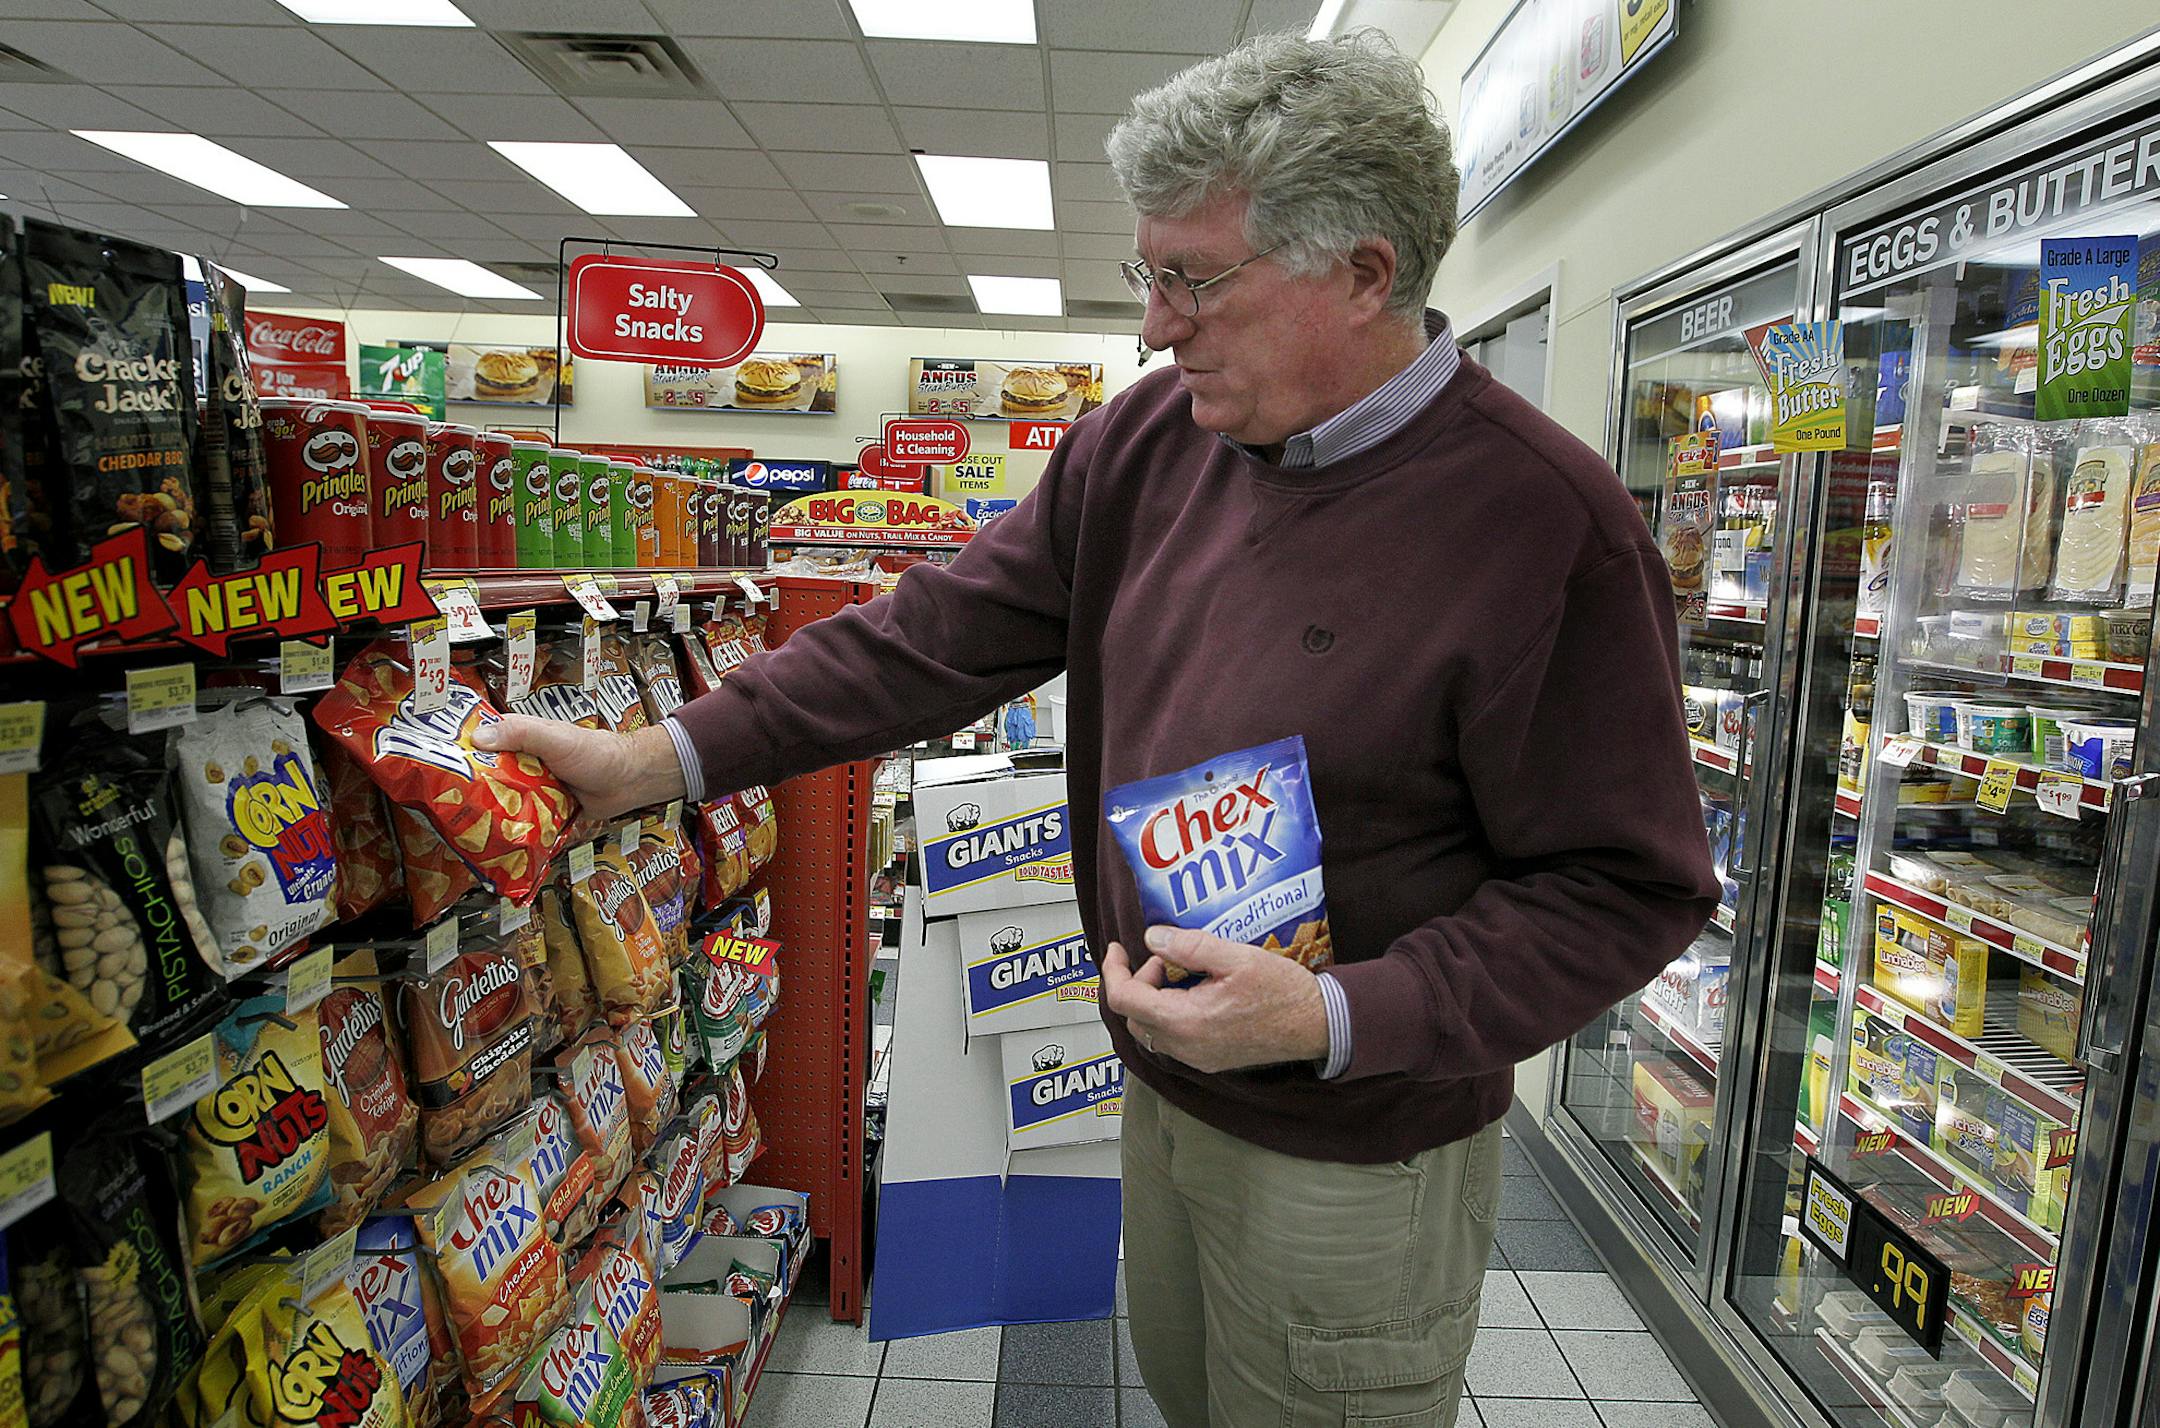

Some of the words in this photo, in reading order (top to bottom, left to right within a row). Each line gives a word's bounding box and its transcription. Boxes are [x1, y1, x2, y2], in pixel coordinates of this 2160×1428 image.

[1849, 217, 1941, 286] EGGS
[1948, 204, 1975, 250] &
[2047, 249, 2082, 267] Grade
[2084, 248, 2093, 265] A
[2096, 247, 2130, 267] Large
[48, 282, 96, 308] NEW!
[628, 283, 694, 316] Salty
[2046, 275, 2130, 339] Fresh
[614, 313, 705, 344] Snacks
[1680, 295, 1735, 343] BEER
[1773, 331, 1800, 346] Grade
[1802, 329, 1815, 343] AA
[1776, 349, 1839, 395] Fresh
[2044, 324, 2125, 386] Eggs
[260, 369, 275, 391] 2
[275, 370, 297, 387] for
[920, 371, 977, 383] ANGUS
[2067, 388, 2090, 404] One
[2091, 387, 2125, 402] Dozen
[929, 399, 940, 413] 2
[1777, 384, 1841, 428] Butter
[895, 430, 956, 442] Household
[895, 444, 906, 456] &
[906, 444, 957, 457] Cleaning
[1796, 430, 1813, 441] One
[1815, 428, 1841, 440] Pound
[99, 450, 161, 473] CHEDDAR
[769, 467, 815, 484] pepsi
[955, 465, 996, 479] SALE
[981, 455, 1003, 466] OUT
[302, 468, 367, 515] Pringles
[959, 480, 990, 490] ITEMS
[808, 499, 855, 524] BIG
[886, 499, 941, 526] BAG
[794, 529, 812, 538] BIG
[814, 529, 844, 539] VALUE
[29, 556, 141, 646] NEW
[185, 567, 302, 637] NEW
[326, 563, 403, 619] EW
[418, 657, 428, 678] 2
[429, 668, 446, 694] $3
[512, 653, 519, 671] 2
[518, 663, 531, 686] $3
[1984, 776, 1990, 785] 2
[67, 798, 158, 846] Wonderful
[233, 759, 320, 848] CORN
[1140, 763, 1275, 870] Chex
[948, 811, 1063, 869] GIANTS
[1004, 847, 1044, 866] Snacks
[287, 865, 317, 896] Ultimate
[1018, 866, 1039, 879] BOLD
[1167, 808, 1287, 916] mix
[113, 837, 190, 1003] PISTACHIOS
[269, 908, 321, 946] Original
[1212, 879, 1309, 940] Traditional
[710, 935, 769, 966] NEW
[1047, 968, 1085, 987] Snacks
[1060, 985, 1081, 998] BOLD
[439, 955, 521, 1051] Gardetto's
[319, 991, 383, 1109] Gardetto's
[470, 1026, 529, 1071] Chipotle
[474, 1034, 532, 1081] Cheddar
[195, 1053, 298, 1143] CORN
[360, 1070, 393, 1113] Original
[1099, 1102, 1119, 1113] BOLD
[237, 1089, 328, 1183] NUTS
[1856, 1133, 1891, 1153] NEW
[262, 1150, 313, 1195] RANCH
[450, 1174, 521, 1251] Chex
[551, 1184, 572, 1213] Bold
[1810, 1179, 1849, 1225] Fresh
[1927, 1194, 1973, 1219] NEW
[471, 1184, 538, 1284] mix
[1810, 1205, 1845, 1245] Eggs
[499, 1244, 546, 1304] Cheddar
[592, 1250, 635, 1319] Chex
[1873, 1241, 1929, 1331] .99
[2017, 1269, 2056, 1290] NE
[606, 1259, 652, 1343] mix
[268, 1321, 346, 1422] CORN
[540, 1323, 595, 1398] Chex
[566, 1328, 613, 1424] mix
